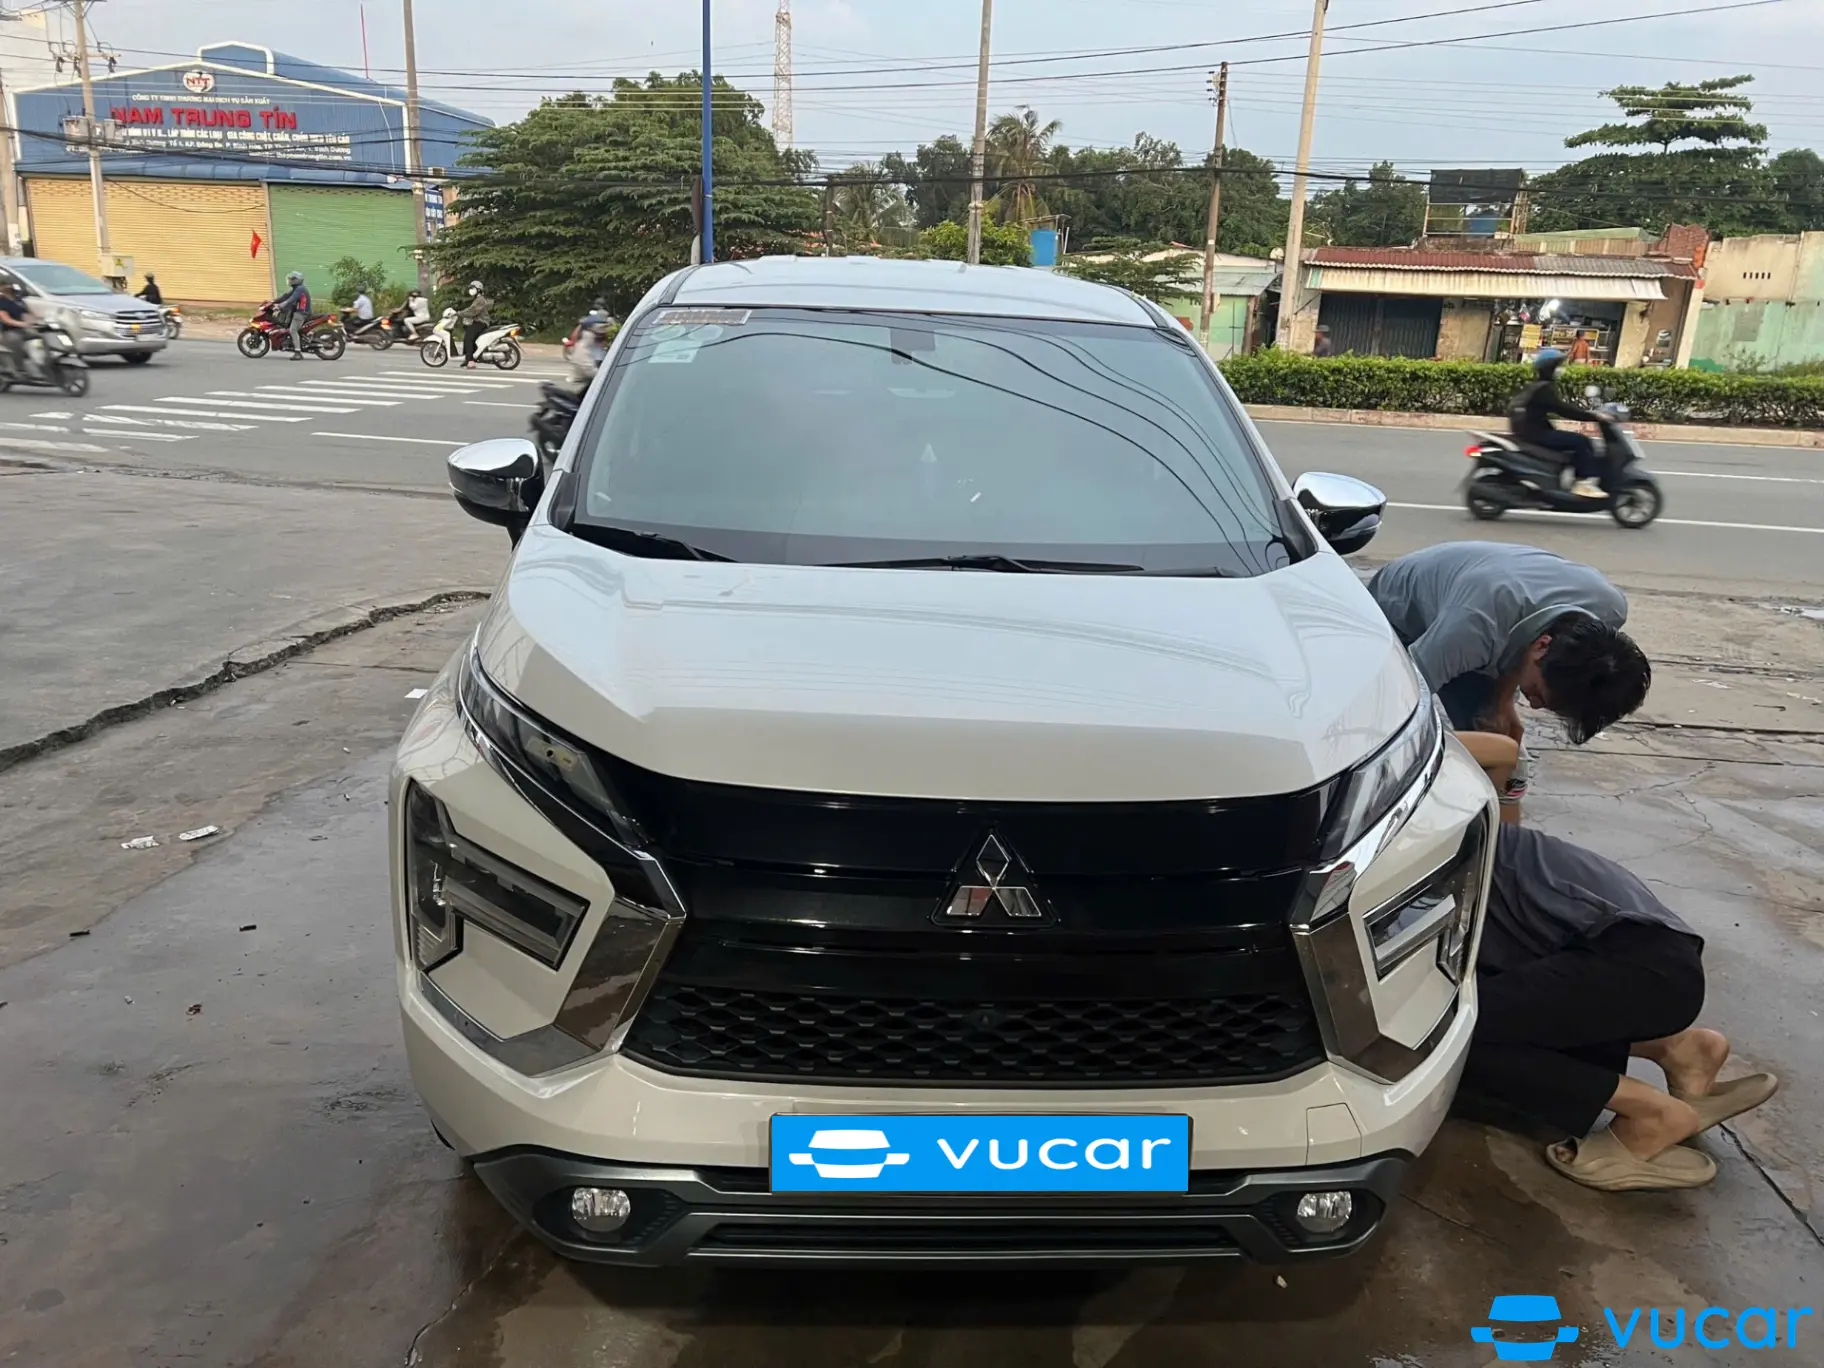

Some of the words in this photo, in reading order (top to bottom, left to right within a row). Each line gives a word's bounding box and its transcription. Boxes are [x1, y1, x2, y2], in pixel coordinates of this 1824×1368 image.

[186, 77, 210, 85] NTT
[110, 107, 164, 125] NAM
[170, 108, 252, 128] TRUNG
[259, 105, 297, 129] TÍN
